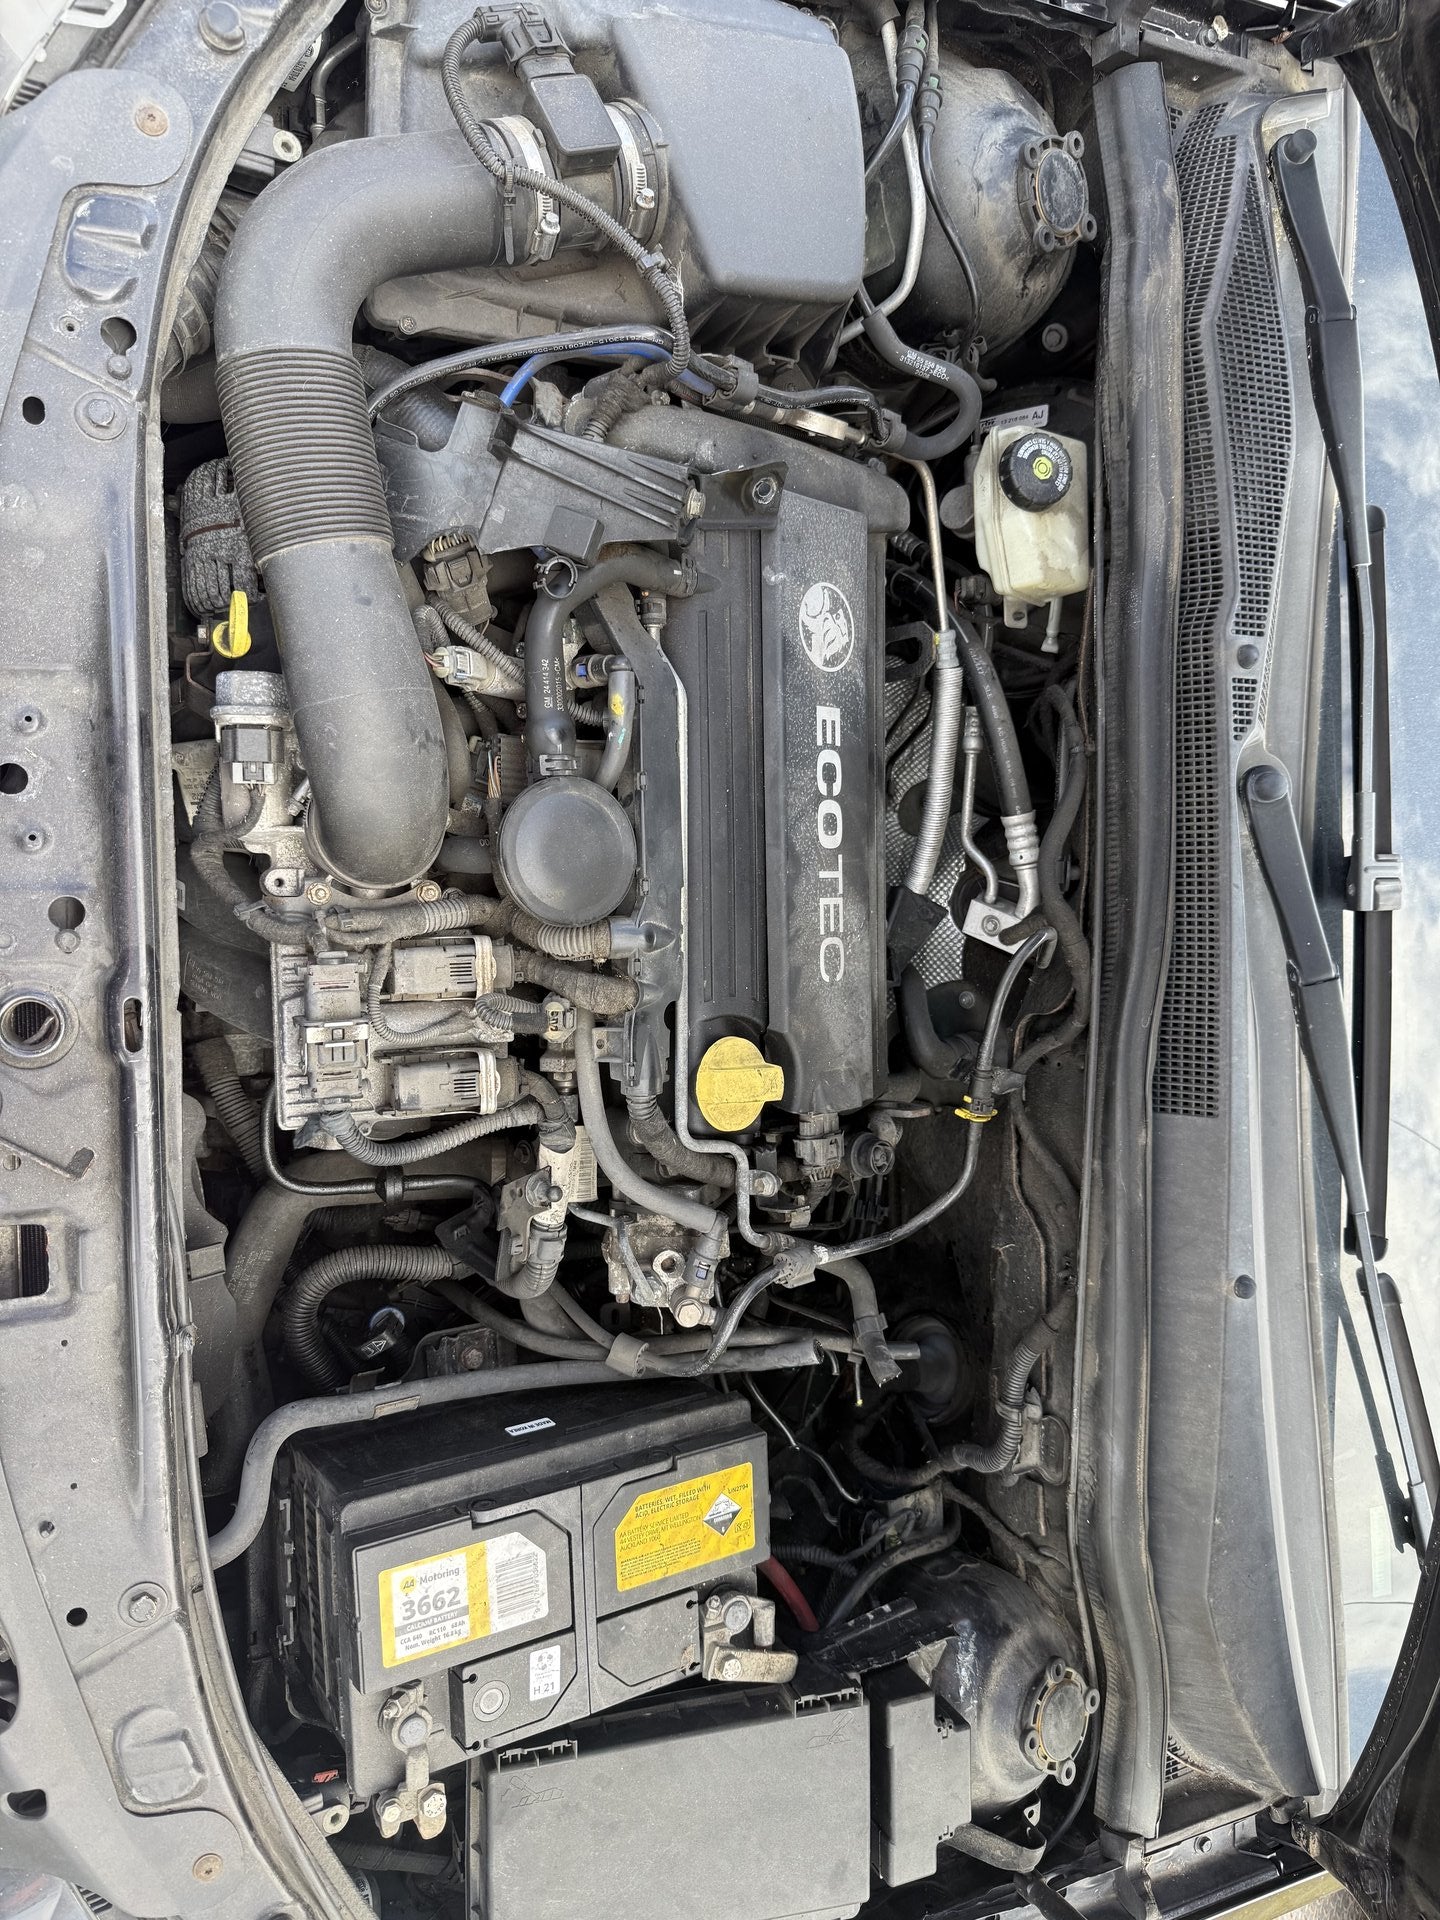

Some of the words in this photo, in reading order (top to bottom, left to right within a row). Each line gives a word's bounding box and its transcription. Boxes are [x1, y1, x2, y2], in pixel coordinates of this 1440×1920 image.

[1031, 409, 1044, 420] AJ
[815, 705, 845, 984] ECOTEC
[651, 1502, 675, 1514] ELECTRIC
[676, 1495, 700, 1507] STORAGE
[419, 1566, 460, 1585] Motoring
[402, 1586, 461, 1621] 3662
[400, 1637, 411, 1645] CCA
[421, 1635, 441, 1645] Weight
[533, 1685, 541, 1696] H
[544, 1681, 555, 1693] 21
